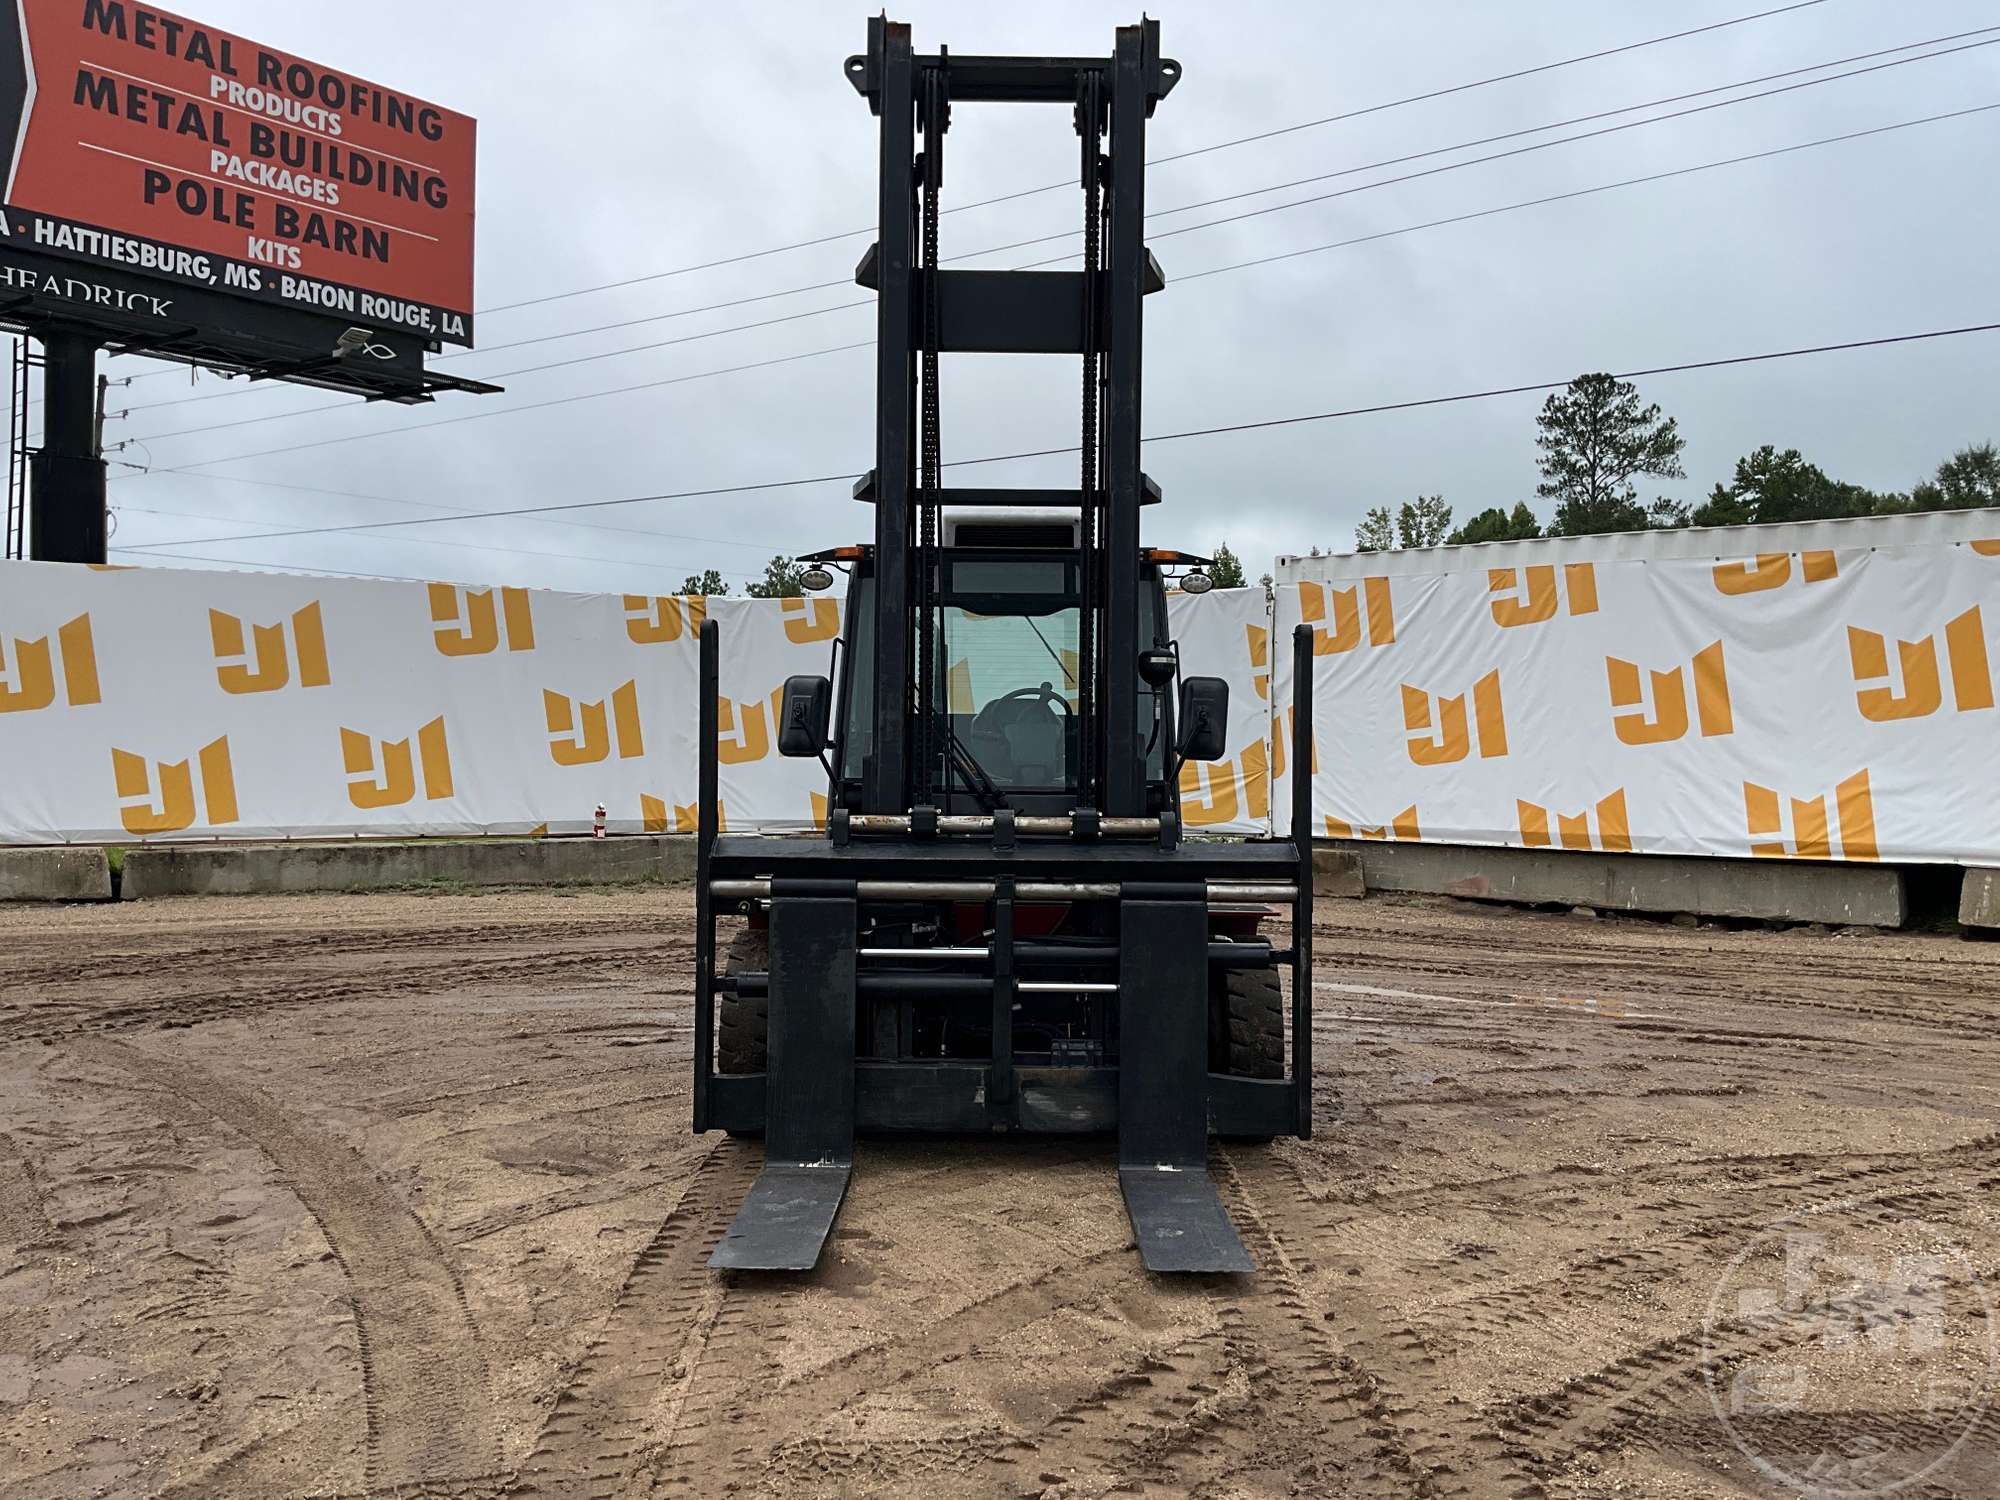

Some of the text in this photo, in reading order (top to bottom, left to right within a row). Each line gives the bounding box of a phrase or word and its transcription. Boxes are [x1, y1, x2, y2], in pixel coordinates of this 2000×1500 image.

[83, 0, 443, 141] METAL ROOFING
[210, 75, 342, 135] PRODUCTS
[73, 70, 448, 208] METAL BUILDING
[210, 149, 339, 205] PACKAGES
[144, 168, 389, 264] POLE BARN
[248, 236, 302, 269] KITS
[34, 218, 218, 286] HATTIESBURG,
[224, 263, 262, 291] MS
[281, 275, 355, 313] BATON
[361, 293, 437, 333] ROUGE,
[442, 312, 465, 337] LA
